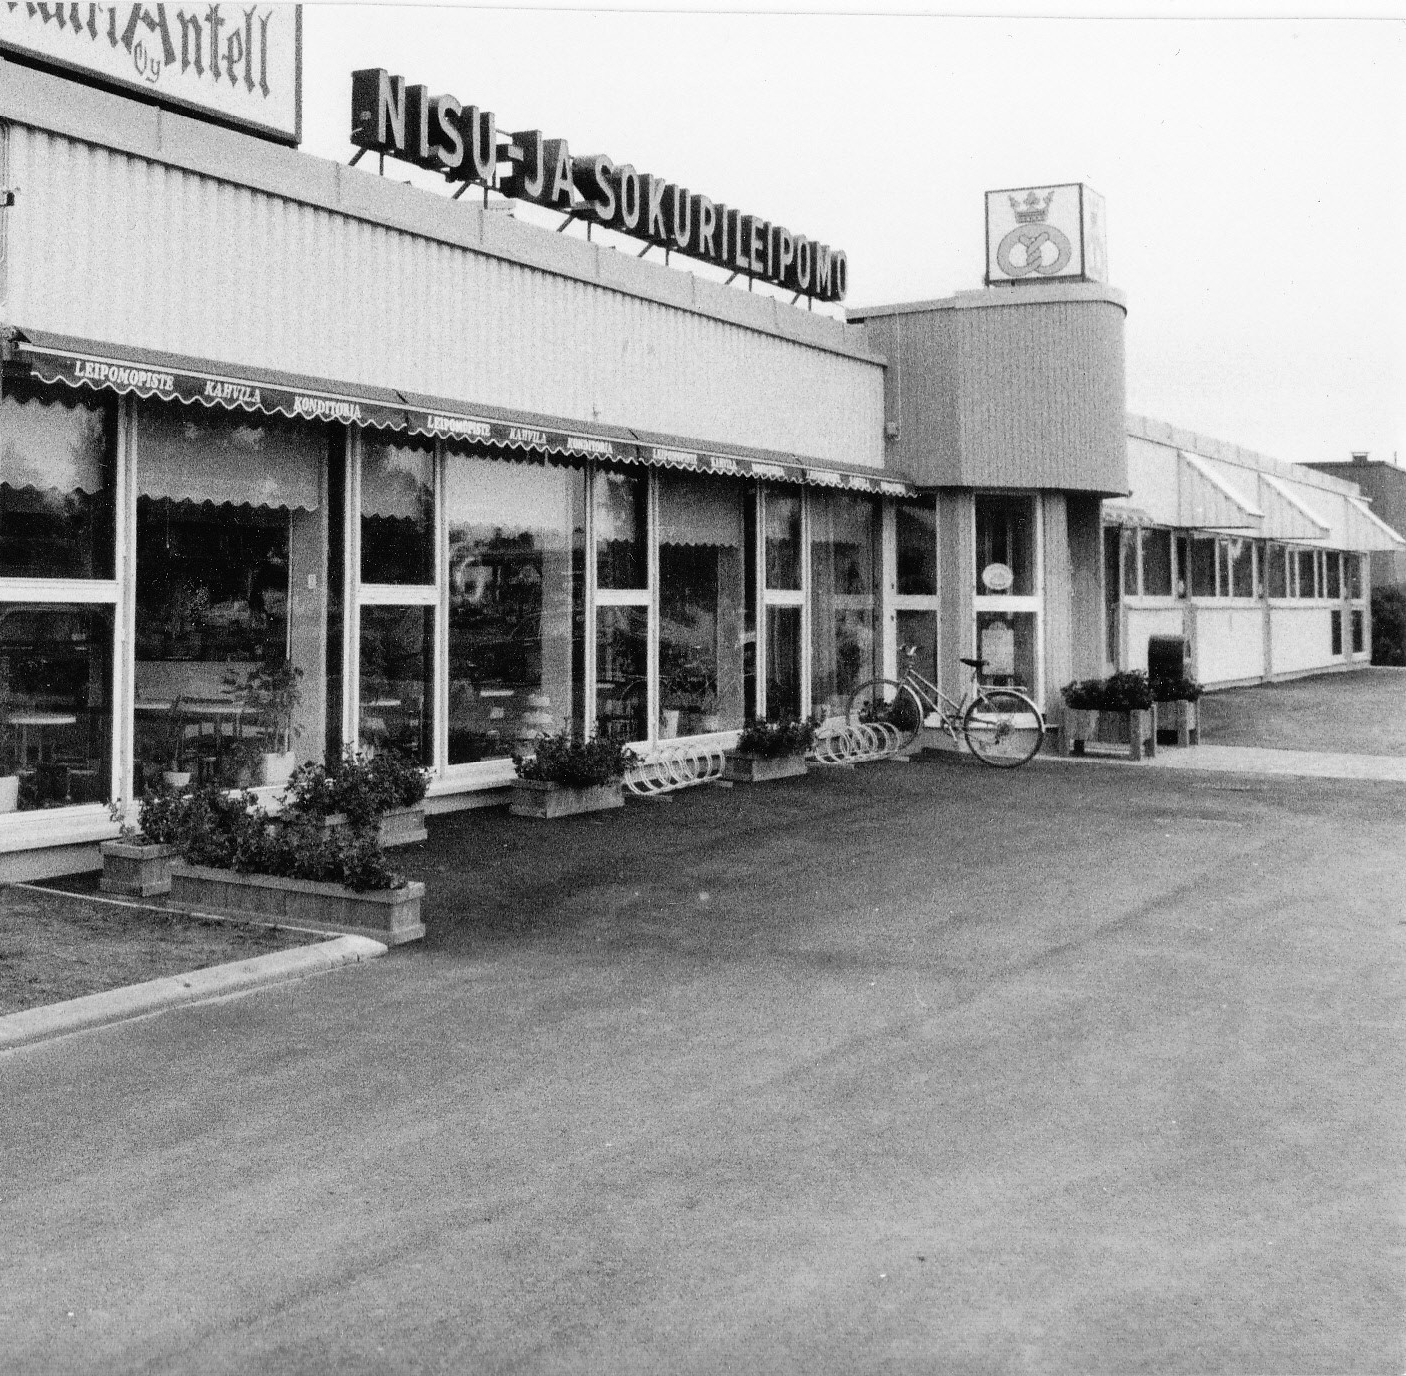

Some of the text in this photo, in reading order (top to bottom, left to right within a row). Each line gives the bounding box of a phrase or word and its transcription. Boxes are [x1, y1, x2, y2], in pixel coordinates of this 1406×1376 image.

[595, 153, 847, 300] SOKURILEIPOMO
[74, 361, 174, 391] LEIPOMOPISTE
[204, 381, 262, 403] KAHVILA
[508, 428, 547, 444] KAHVILA
